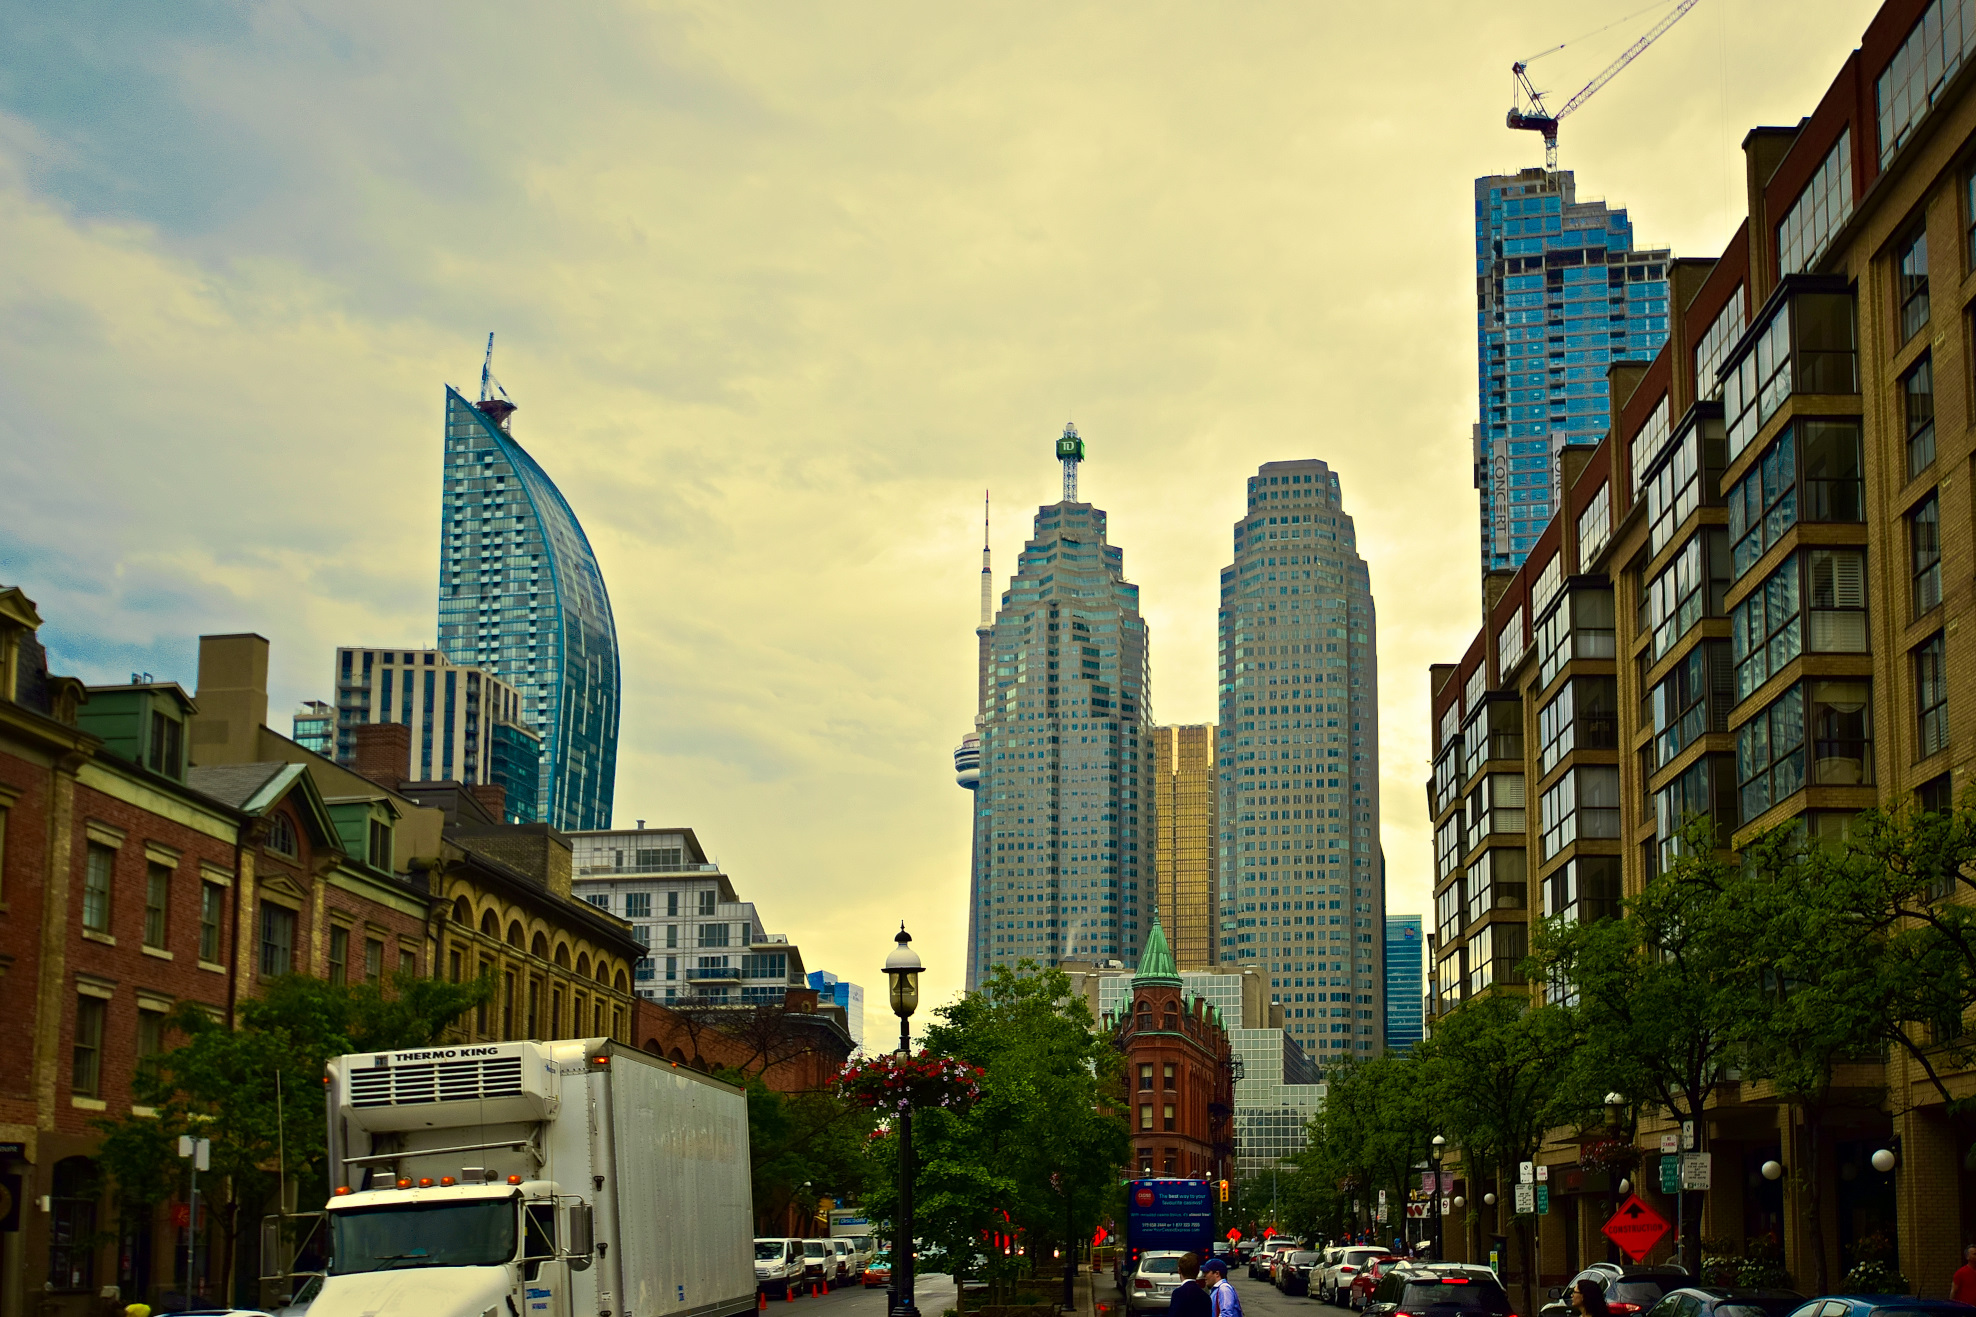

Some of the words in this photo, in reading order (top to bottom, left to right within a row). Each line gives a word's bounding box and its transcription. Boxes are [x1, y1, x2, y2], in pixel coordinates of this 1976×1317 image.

[1061, 441, 1075, 451] TD
[1495, 455, 1507, 534] CONCERT
[395, 1050, 457, 1061] THERMO
[460, 1047, 499, 1057] KING
[1608, 1223, 1664, 1234] CONSTRUCTION
